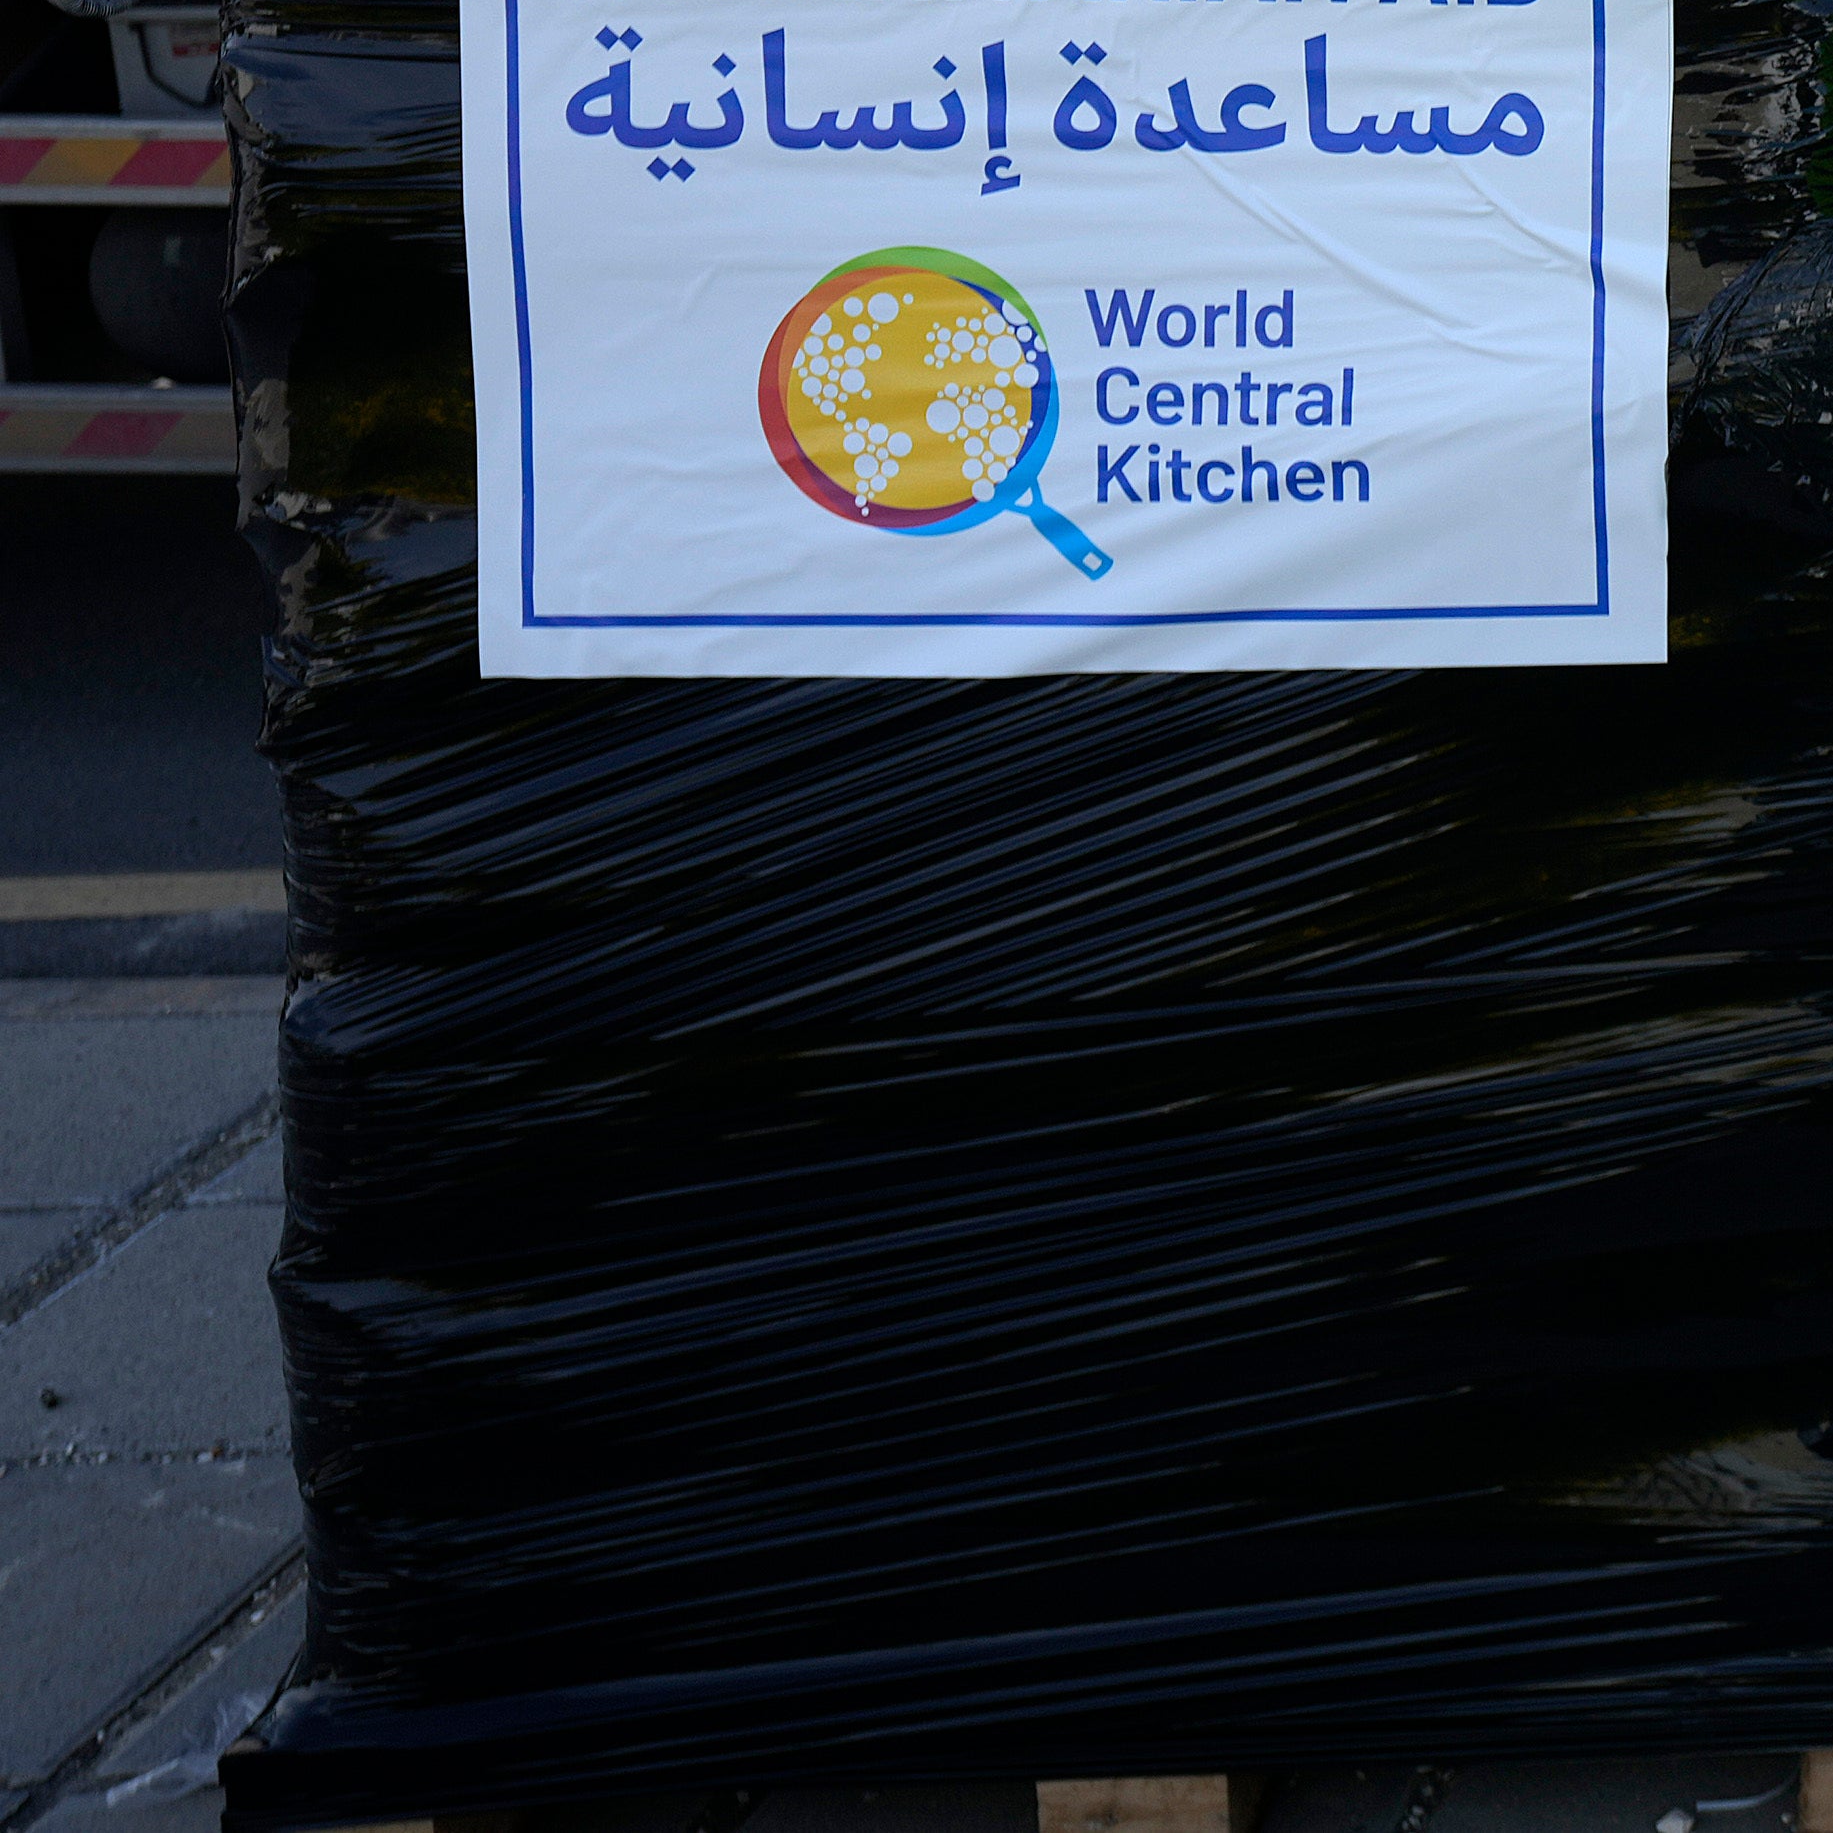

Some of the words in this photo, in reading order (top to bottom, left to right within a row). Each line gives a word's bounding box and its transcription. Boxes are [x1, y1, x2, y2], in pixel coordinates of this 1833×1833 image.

[566, 25, 1021, 197] إنسانية
[1053, 33, 1545, 157] مساعدة
[1085, 289, 1294, 349] World
[1096, 367, 1355, 427] Central
[1097, 444, 1370, 504] Kitchen
